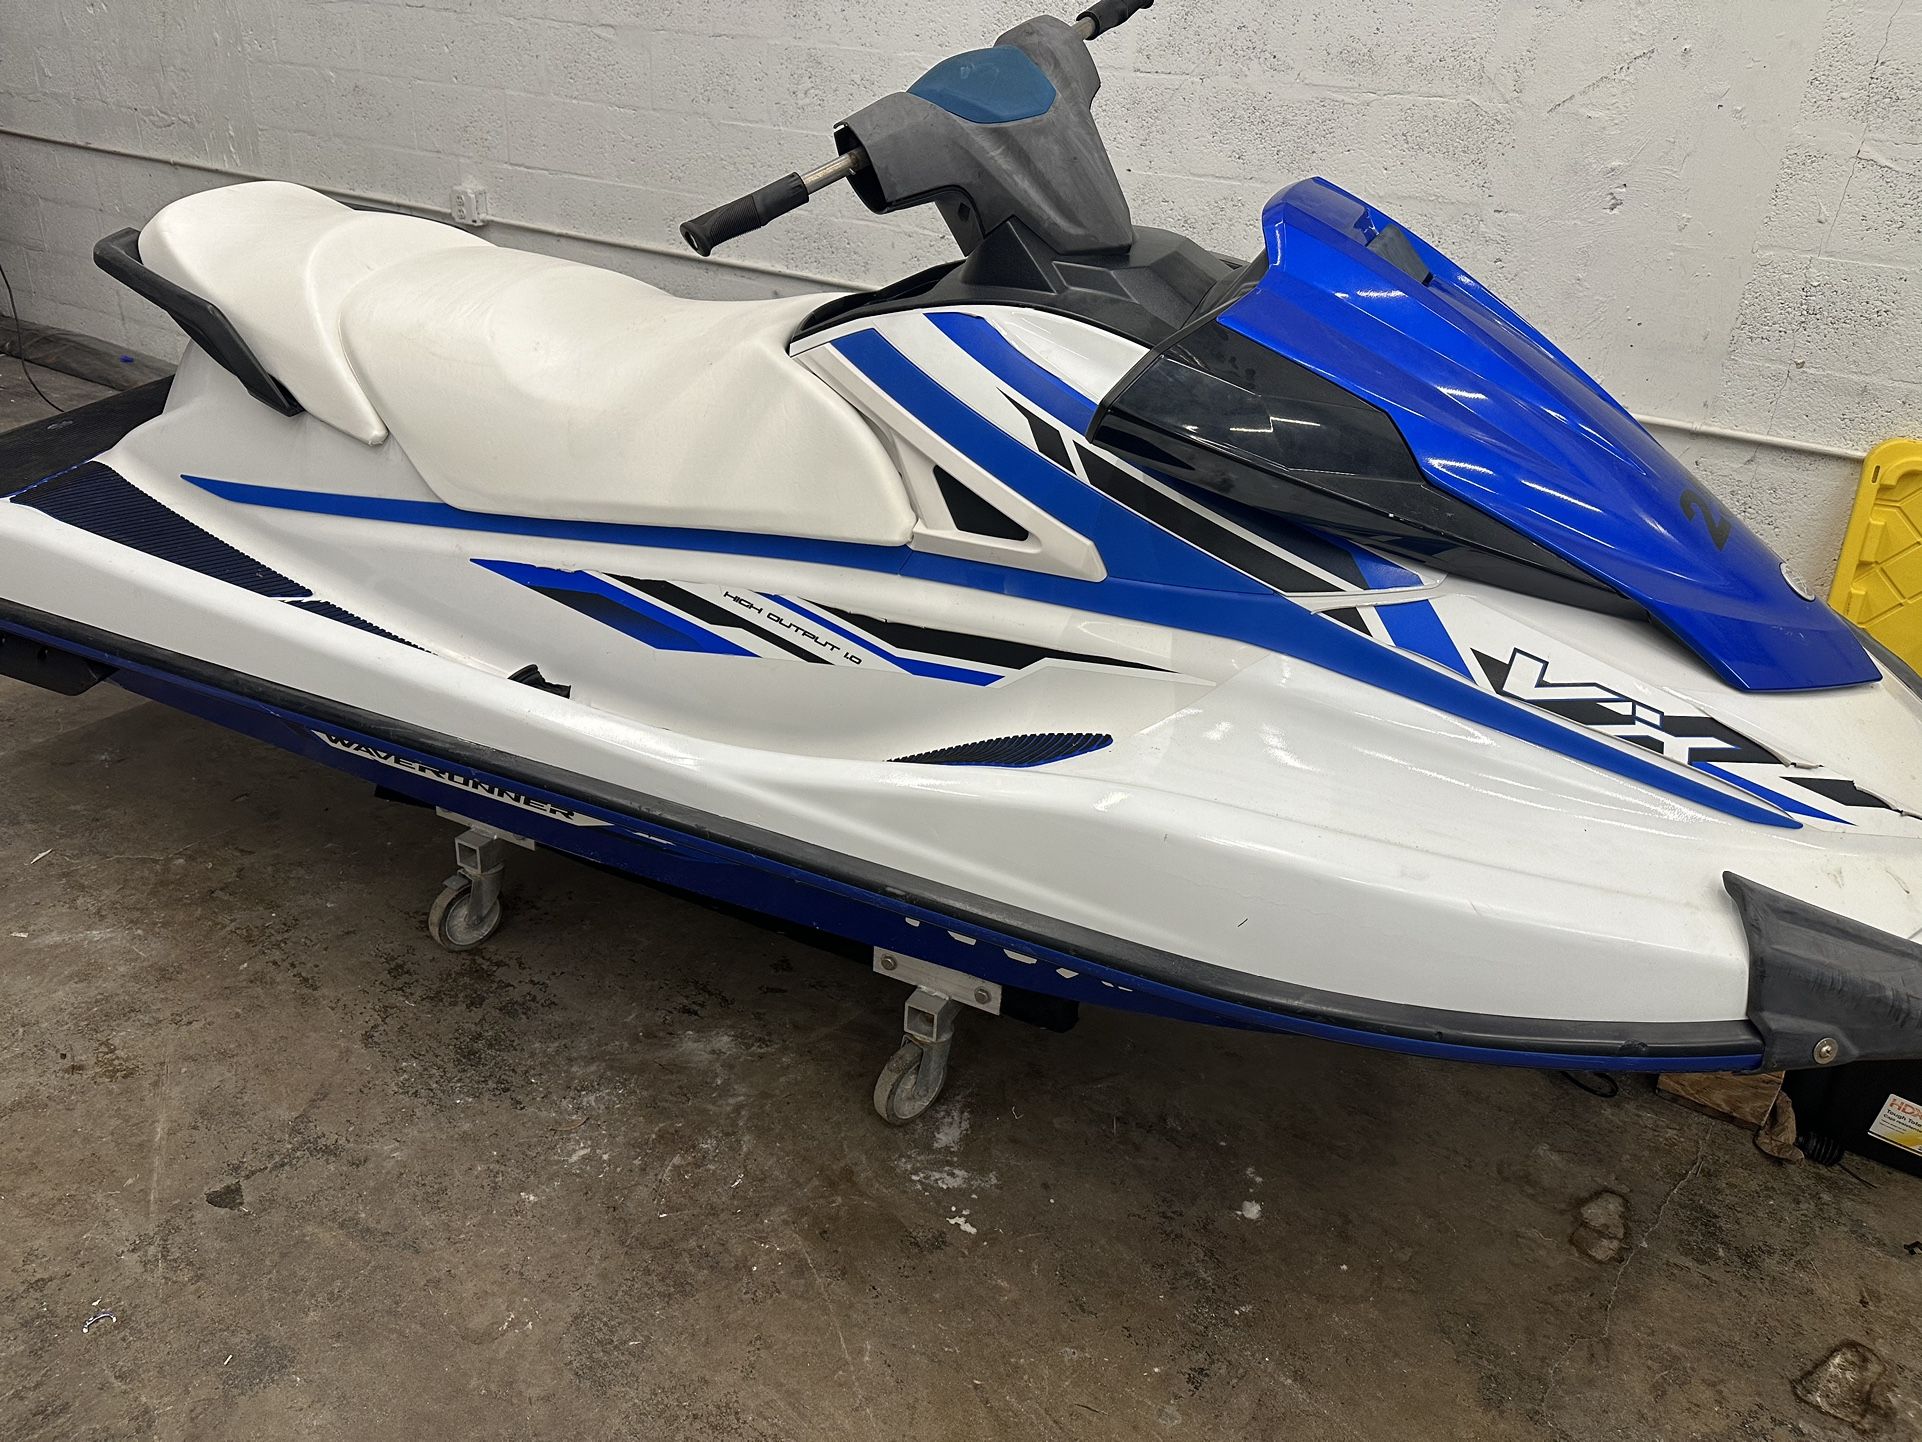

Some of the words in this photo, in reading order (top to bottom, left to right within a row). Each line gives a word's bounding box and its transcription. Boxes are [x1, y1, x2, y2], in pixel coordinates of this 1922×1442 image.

[1680, 489, 1731, 551] 2
[723, 591, 763, 614] HIGH
[766, 612, 841, 652] OUTPUT
[843, 651, 863, 665] 1.0
[1502, 647, 1741, 765] VX
[324, 733, 575, 820] WAVERUNNER
[1886, 1108, 1907, 1121] Tough
